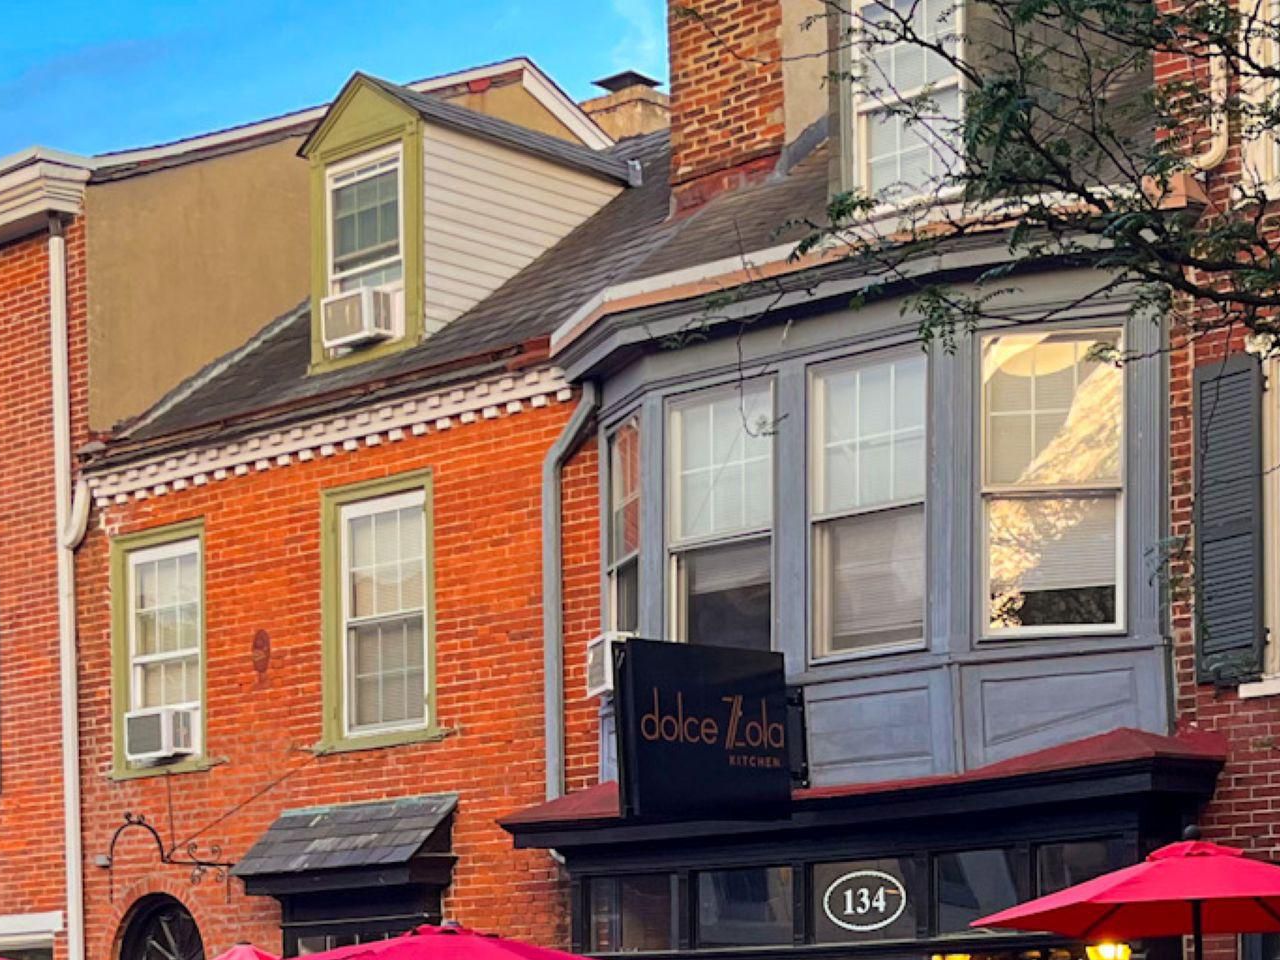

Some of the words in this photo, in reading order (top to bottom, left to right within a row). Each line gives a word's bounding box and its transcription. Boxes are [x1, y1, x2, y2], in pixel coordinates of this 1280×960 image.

[640, 686, 719, 745] dolce
[721, 694, 785, 750] Zola
[728, 754, 781, 768] KITCHEN
[843, 886, 887, 915] 134
